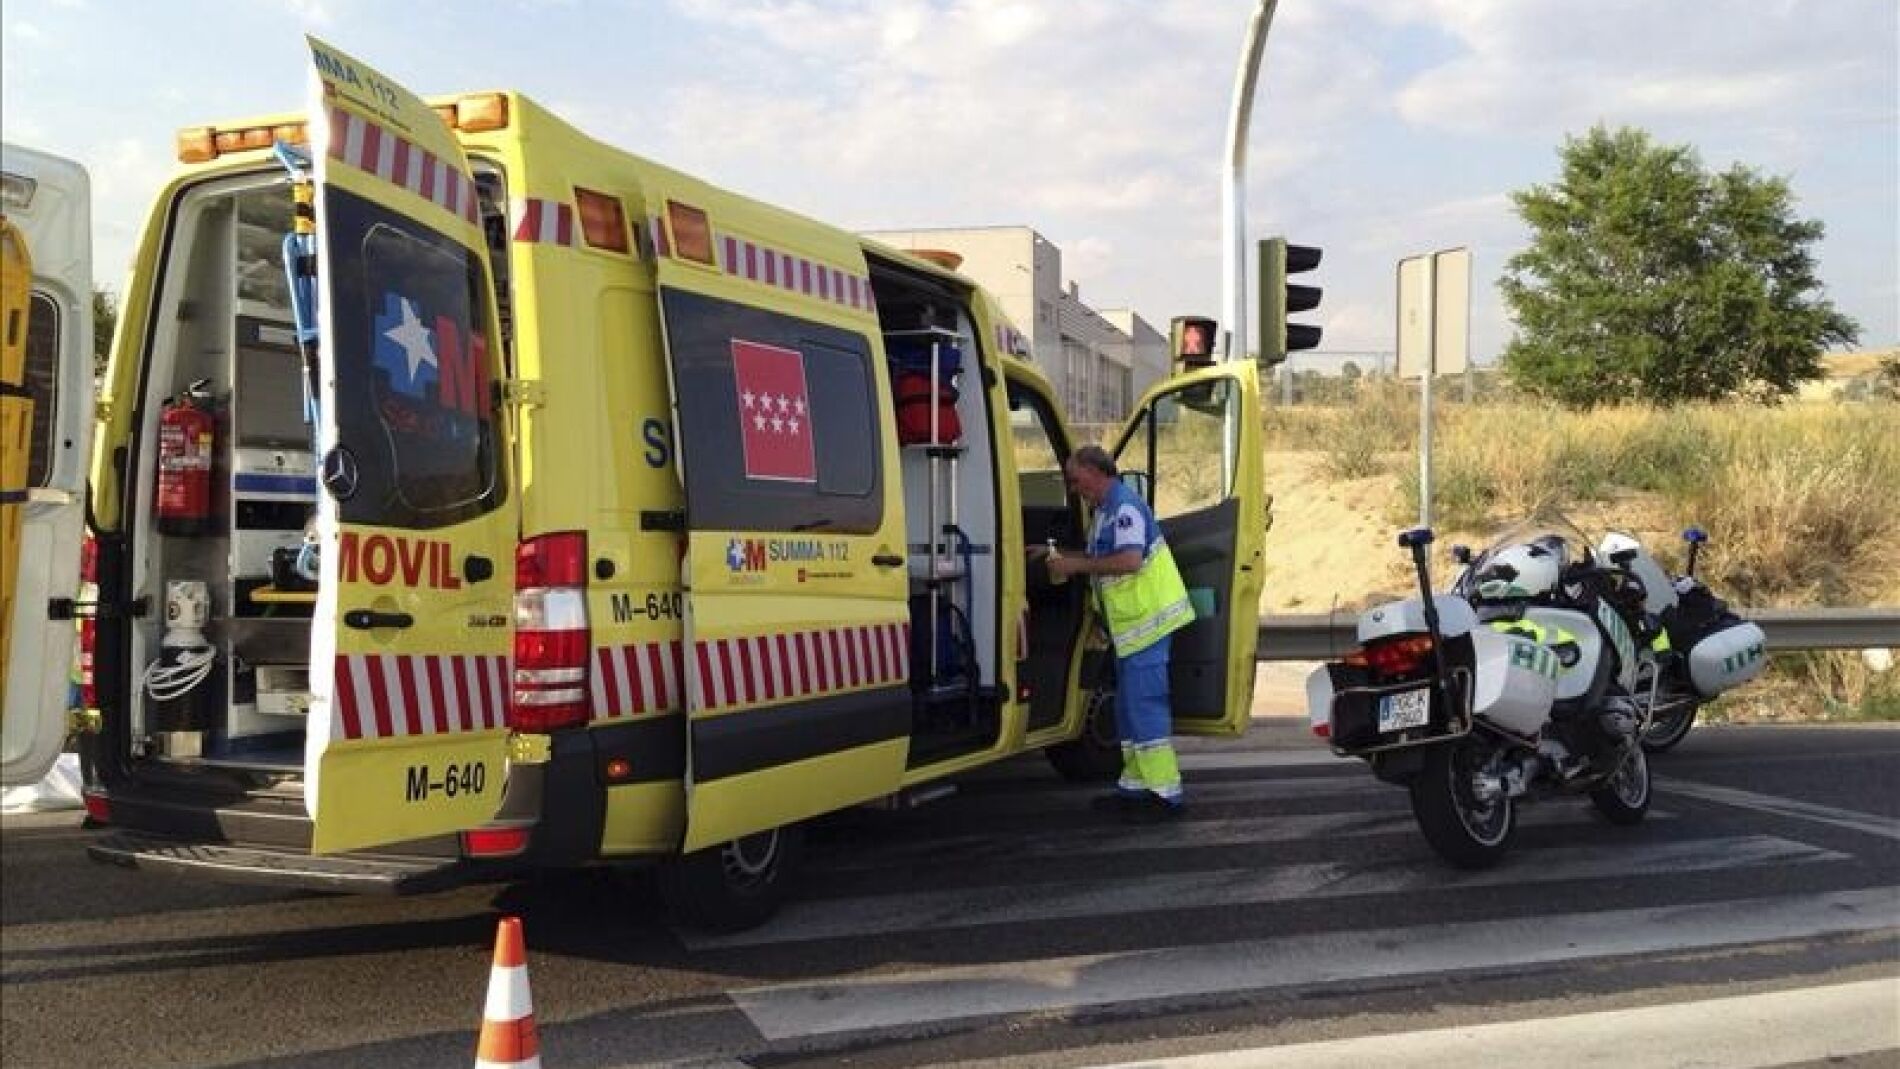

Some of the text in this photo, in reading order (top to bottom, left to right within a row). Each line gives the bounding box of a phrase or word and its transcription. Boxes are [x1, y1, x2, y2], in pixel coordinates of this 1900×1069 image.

[769, 539, 825, 561] SUMMA
[828, 542, 849, 561] 112
[611, 593, 683, 623] M-640
[406, 762, 485, 802] M-640
